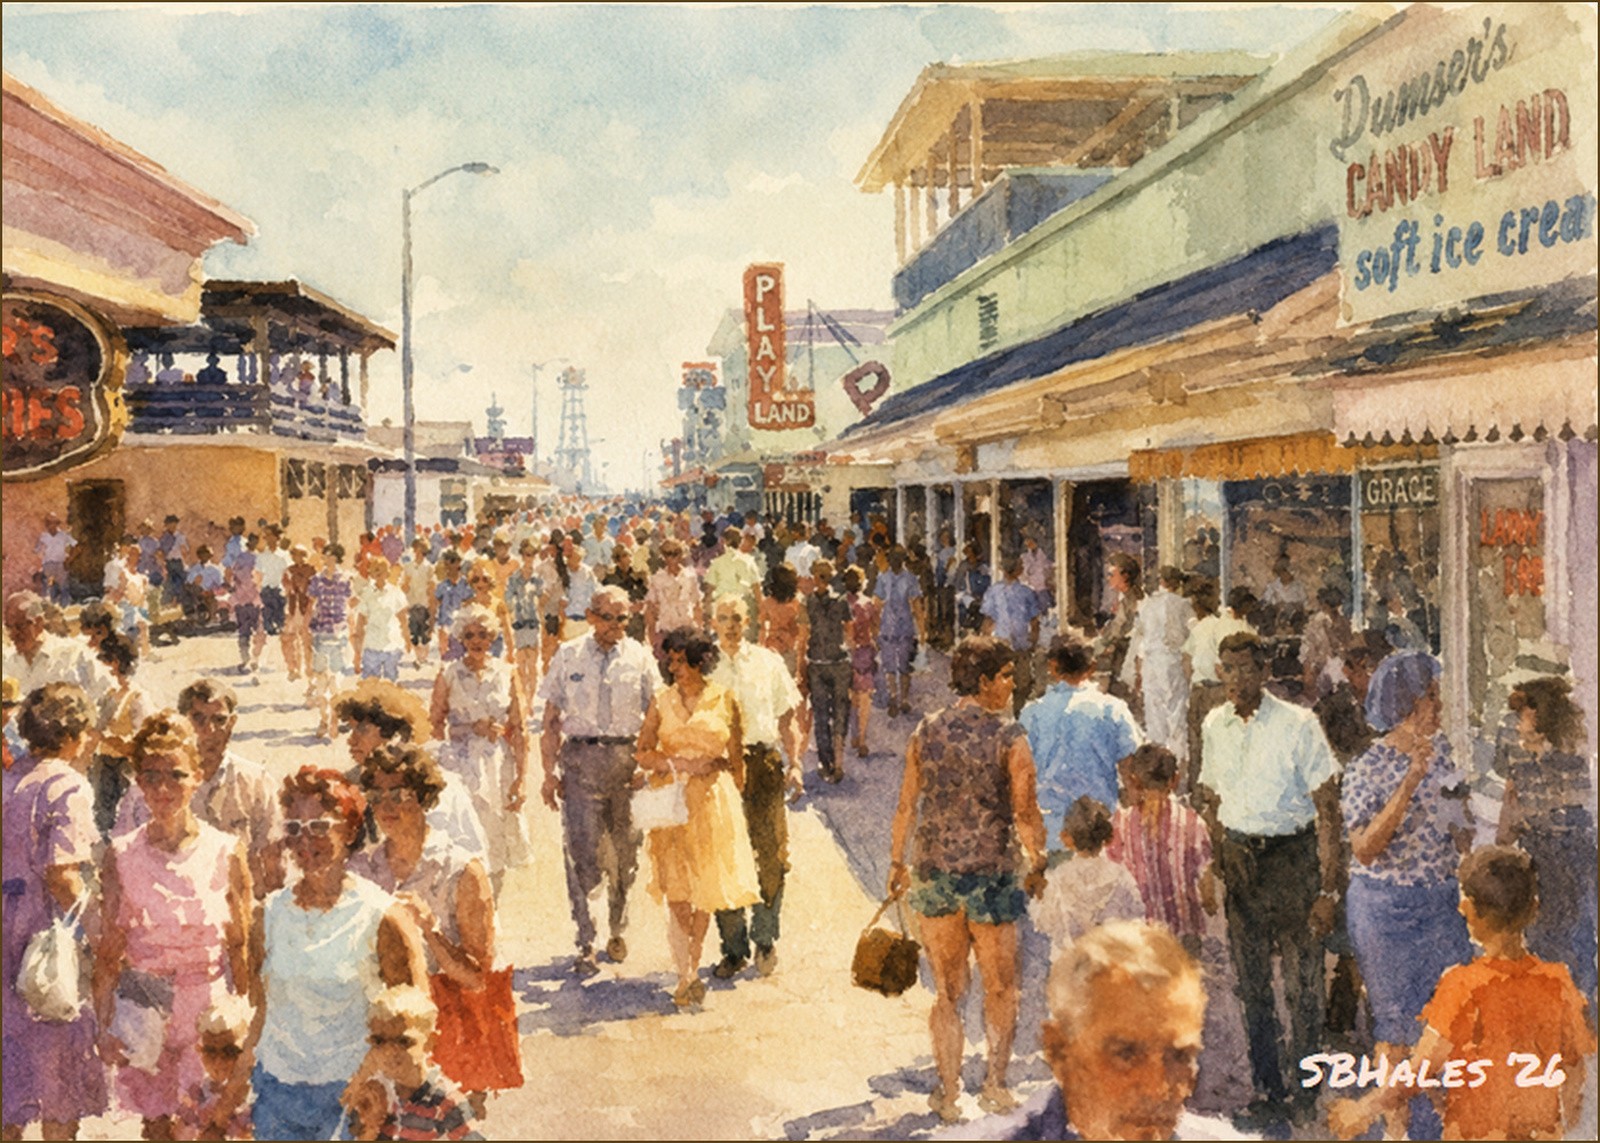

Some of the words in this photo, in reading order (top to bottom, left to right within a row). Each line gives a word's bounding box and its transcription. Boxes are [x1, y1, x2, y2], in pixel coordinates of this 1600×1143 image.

[1330, 17, 1510, 163] Dumser's
[1346, 125, 1455, 219] CANDY
[1473, 88, 1571, 180] LAND
[1354, 219, 1422, 292] soft
[1430, 213, 1485, 273] ice
[756, 274, 777, 393] PLAY
[754, 401, 810, 424] LAND
[1367, 475, 1436, 505] GRACE
